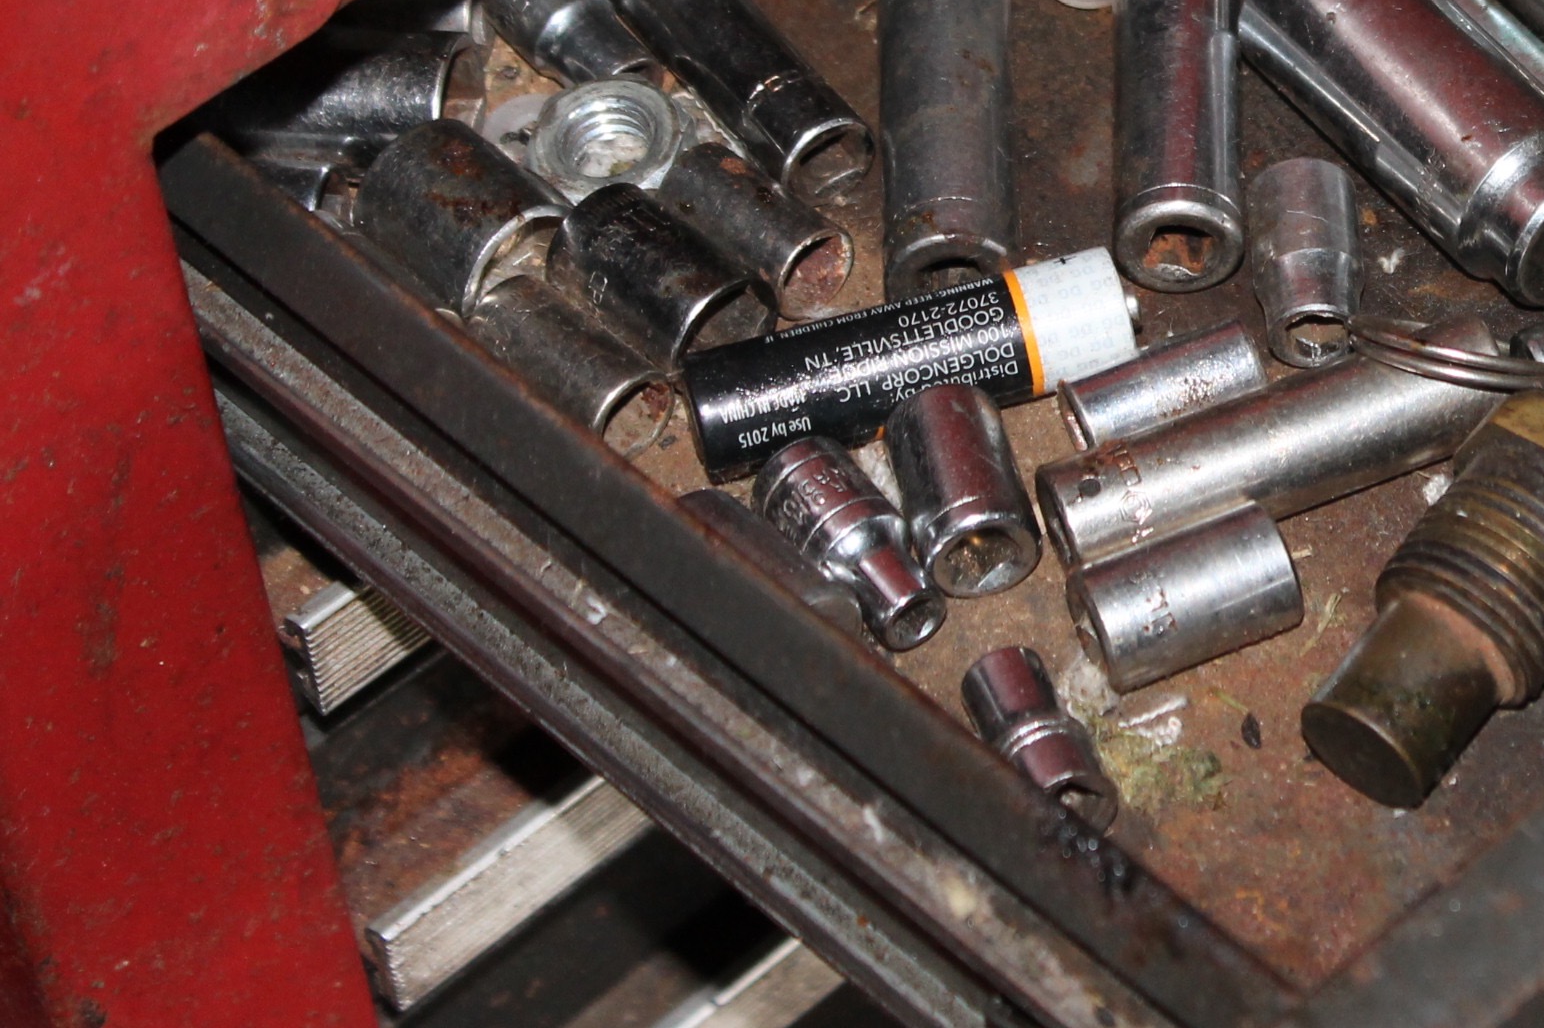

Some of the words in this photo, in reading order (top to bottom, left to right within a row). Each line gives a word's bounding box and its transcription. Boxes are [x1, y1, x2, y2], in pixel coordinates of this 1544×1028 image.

[897, 290, 999, 328] 37072-2170
[835, 306, 1004, 362] GOODLETTSVILLE,
[804, 351, 832, 371] TN
[874, 340, 1015, 390] DOLGENCORP,
[834, 379, 871, 402] LLC
[771, 421, 787, 437] by
[787, 415, 811, 432] Use
[737, 426, 769, 448] 2015
